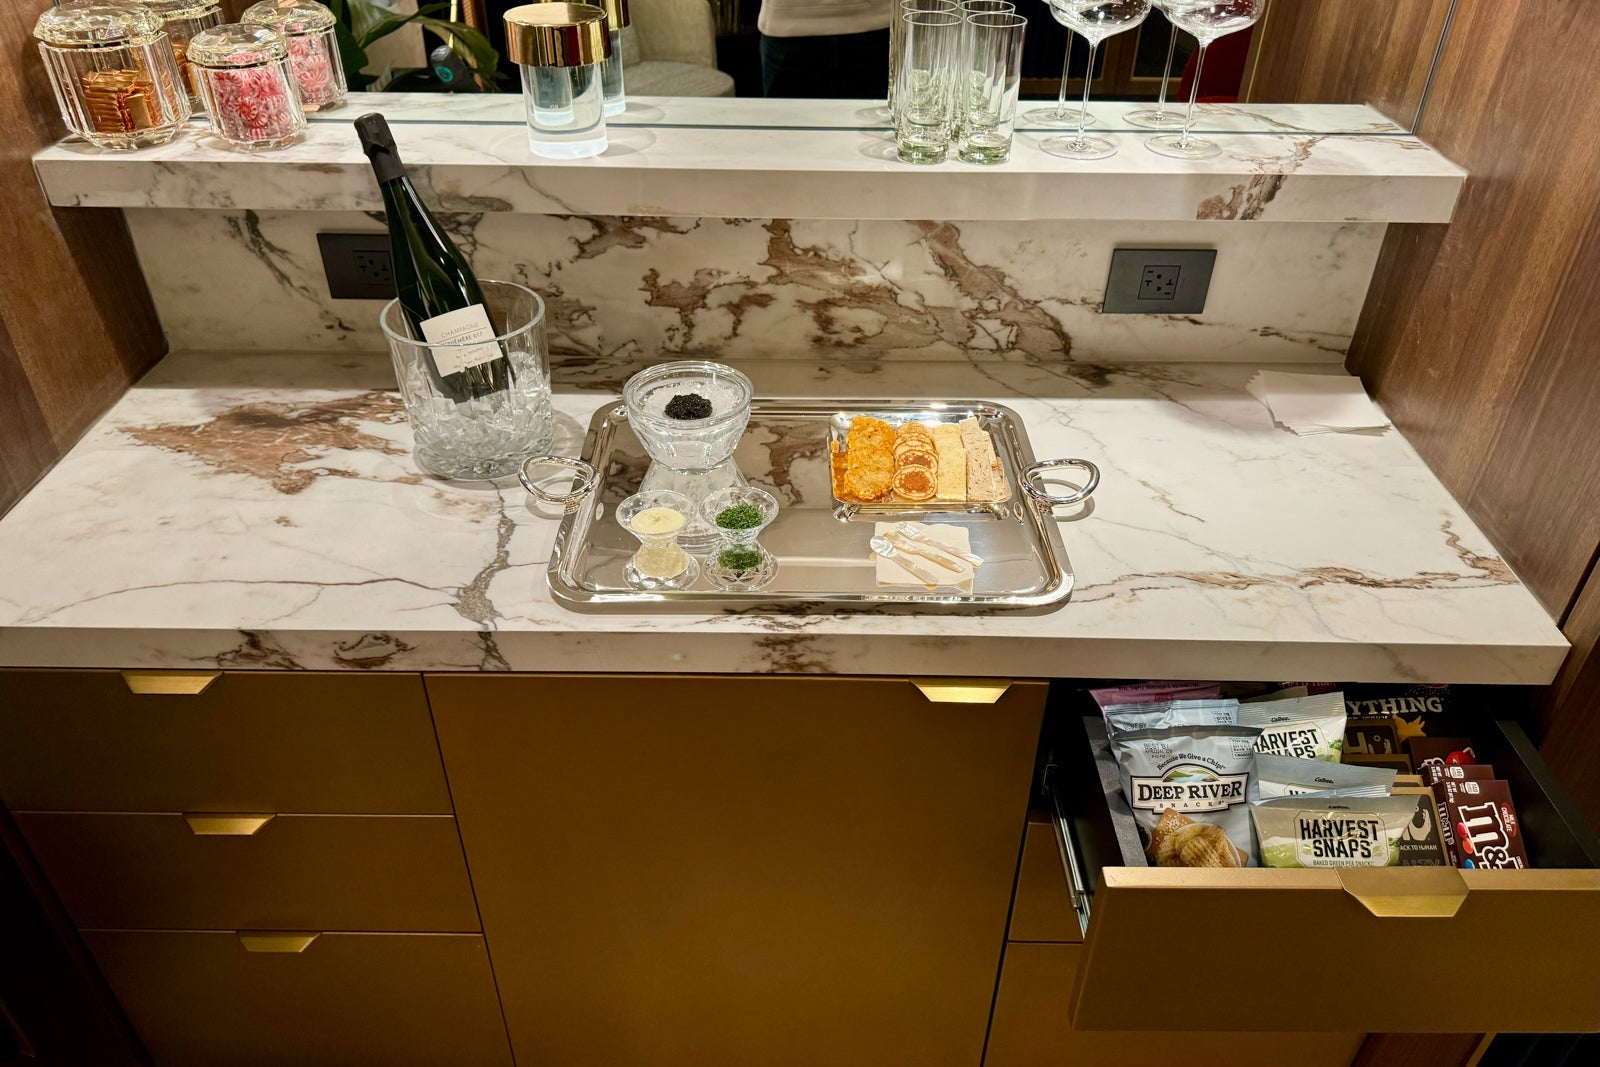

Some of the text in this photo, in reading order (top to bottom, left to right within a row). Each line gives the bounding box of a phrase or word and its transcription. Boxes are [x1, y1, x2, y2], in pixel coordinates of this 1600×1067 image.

[440, 322, 481, 339] CHAMPAGNE
[1345, 696, 1444, 717] YTHING
[1156, 755, 1179, 771] Because
[1187, 753, 1202, 761] Give
[1206, 758, 1223, 770] Chip!
[1137, 780, 1243, 801] DEEP RIVER
[1159, 801, 1224, 809] SNACKS
[1300, 819, 1379, 841] HARVEST
[1501, 807, 1513, 833] CHOCOLATE
[1312, 839, 1372, 859] SNAPS
[1419, 844, 1438, 852] HUMAN
